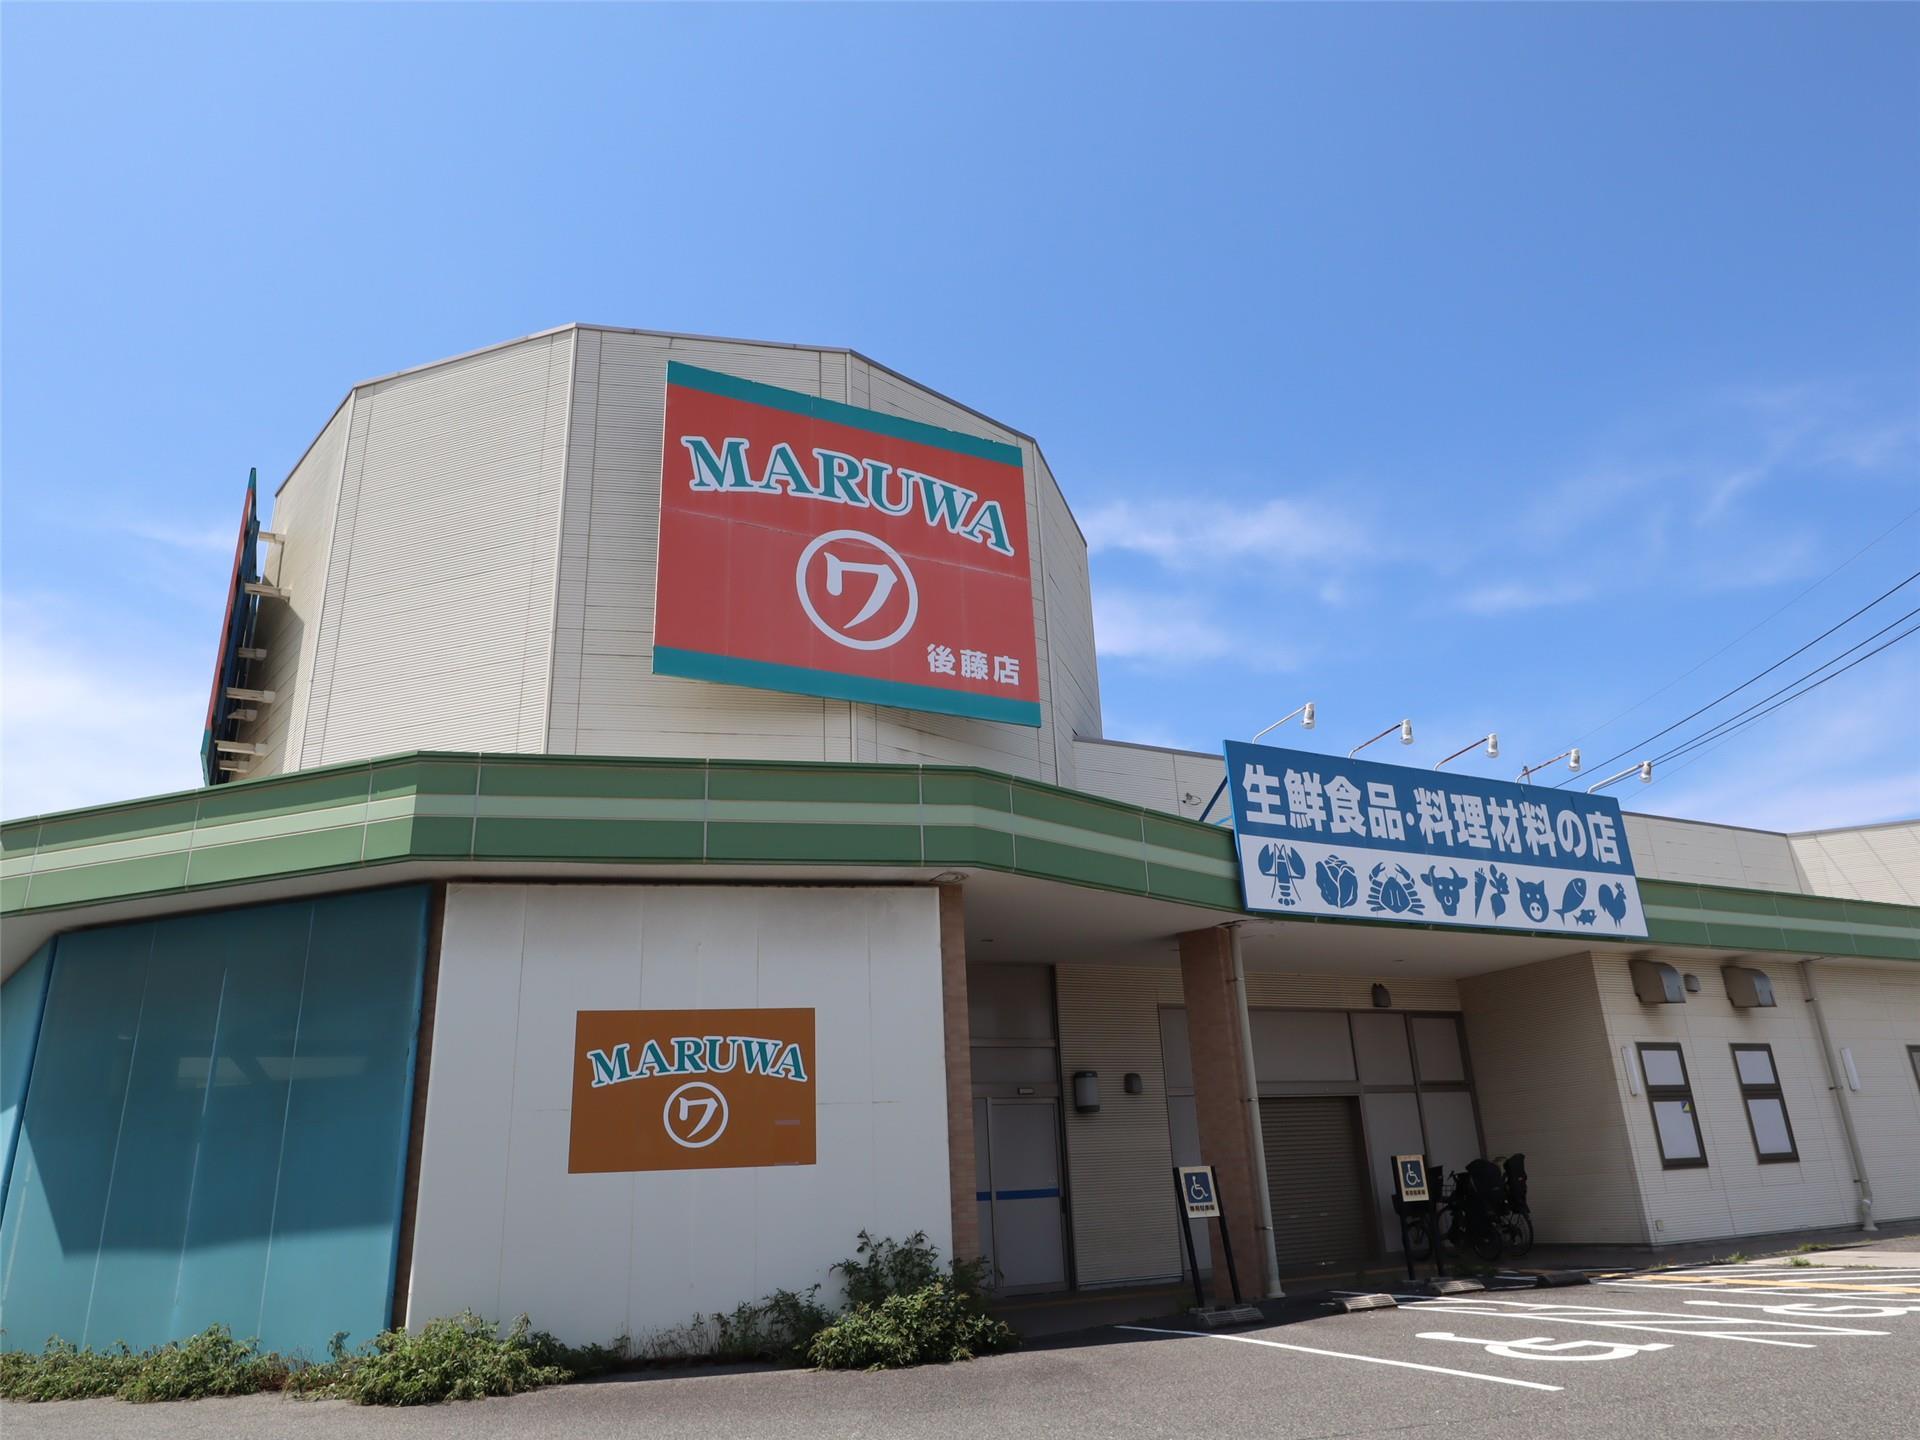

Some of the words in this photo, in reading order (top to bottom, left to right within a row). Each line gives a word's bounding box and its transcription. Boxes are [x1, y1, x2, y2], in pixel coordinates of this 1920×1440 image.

[681, 436, 1014, 556] MARUWA
[927, 643, 1020, 686] 後藤店
[1242, 764, 1621, 865] 生鮮食品・料理材料の店
[587, 1036, 807, 1088] MARUWA
